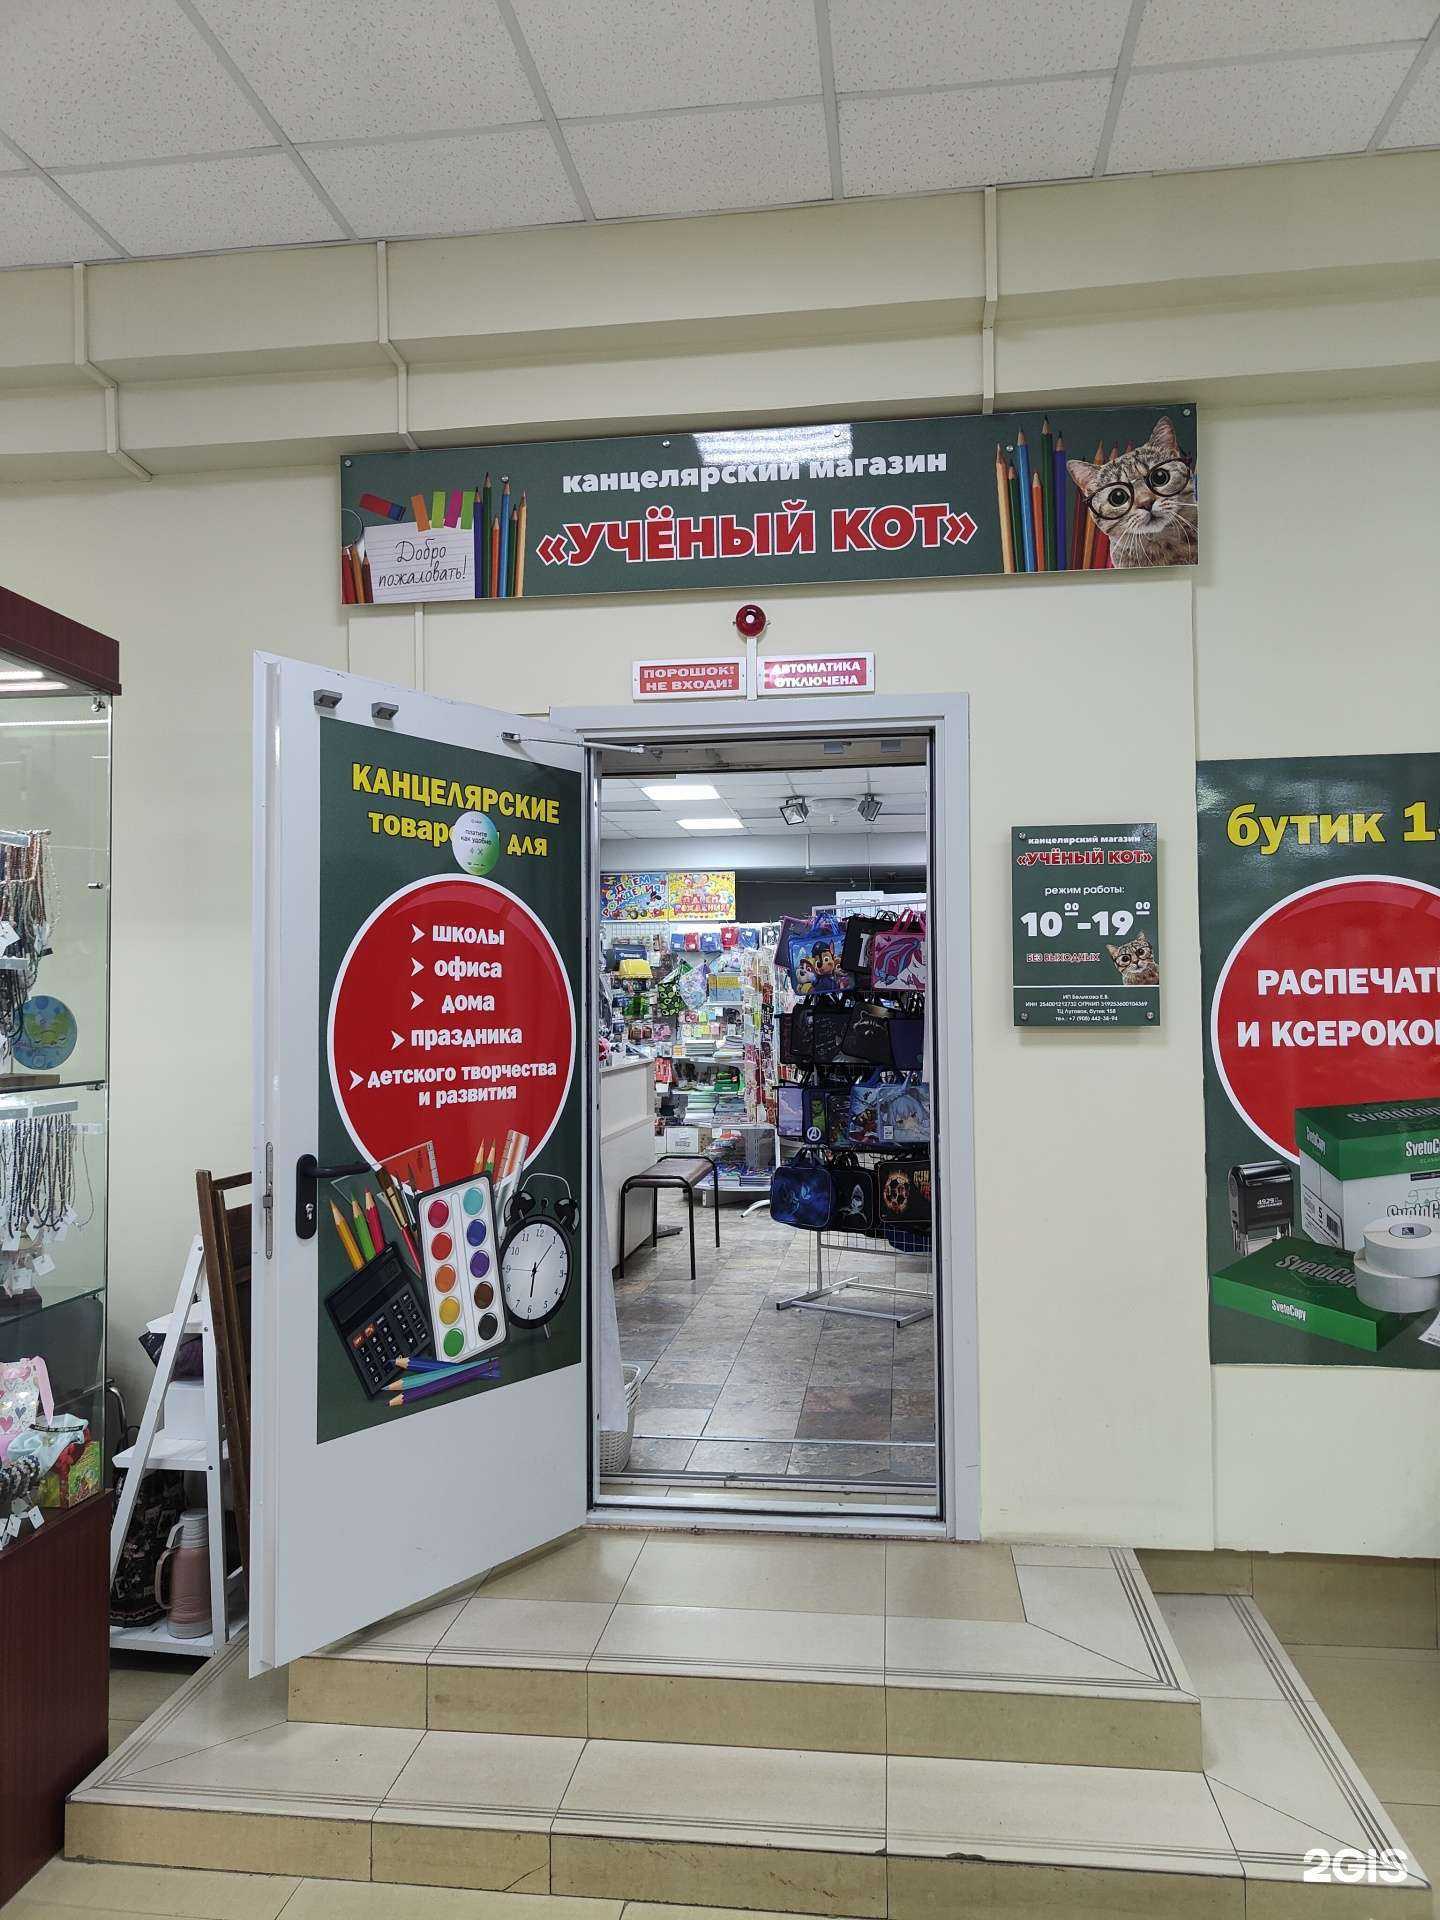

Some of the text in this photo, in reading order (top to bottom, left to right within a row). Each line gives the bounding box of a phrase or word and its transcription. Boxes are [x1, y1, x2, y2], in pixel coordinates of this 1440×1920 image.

[562, 453, 948, 494] канцелярский магазин
[536, 498, 978, 567] «УЧЁНЫЙ КОТ»
[395, 538, 447, 567] Добро
[378, 555, 467, 587] пожаловать!
[643, 665, 735, 679] ПОРОШОК!
[771, 661, 861, 676] АВТОМАТИКА
[645, 678, 733, 692] НЕ ВХОДИ!
[774, 675, 859, 688] ОТКЛЮЧЕНА
[352, 763, 560, 825] КАНЦЕЛЯРСКИЕ
[1226, 801, 1440, 855] бутик 1
[506, 833, 548, 857] для
[1028, 835, 1141, 846] канцелярский магазин
[1017, 847, 1153, 866] «УЧЁНЫЙ КОТ»
[1045, 885, 1126, 896] режим работы:
[432, 925, 505, 946] школы
[434, 956, 503, 981] офиса
[1257, 966, 1440, 996] РАСПЕЧАТ
[441, 994, 495, 1014] дома
[411, 1027, 522, 1050] праздника
[1237, 1019, 1440, 1047] И КСЕРОКО
[367, 1062, 557, 1088] детского творчества
[418, 1085, 517, 1108] и развития
[1405, 1138, 1440, 1157] SvetoC
